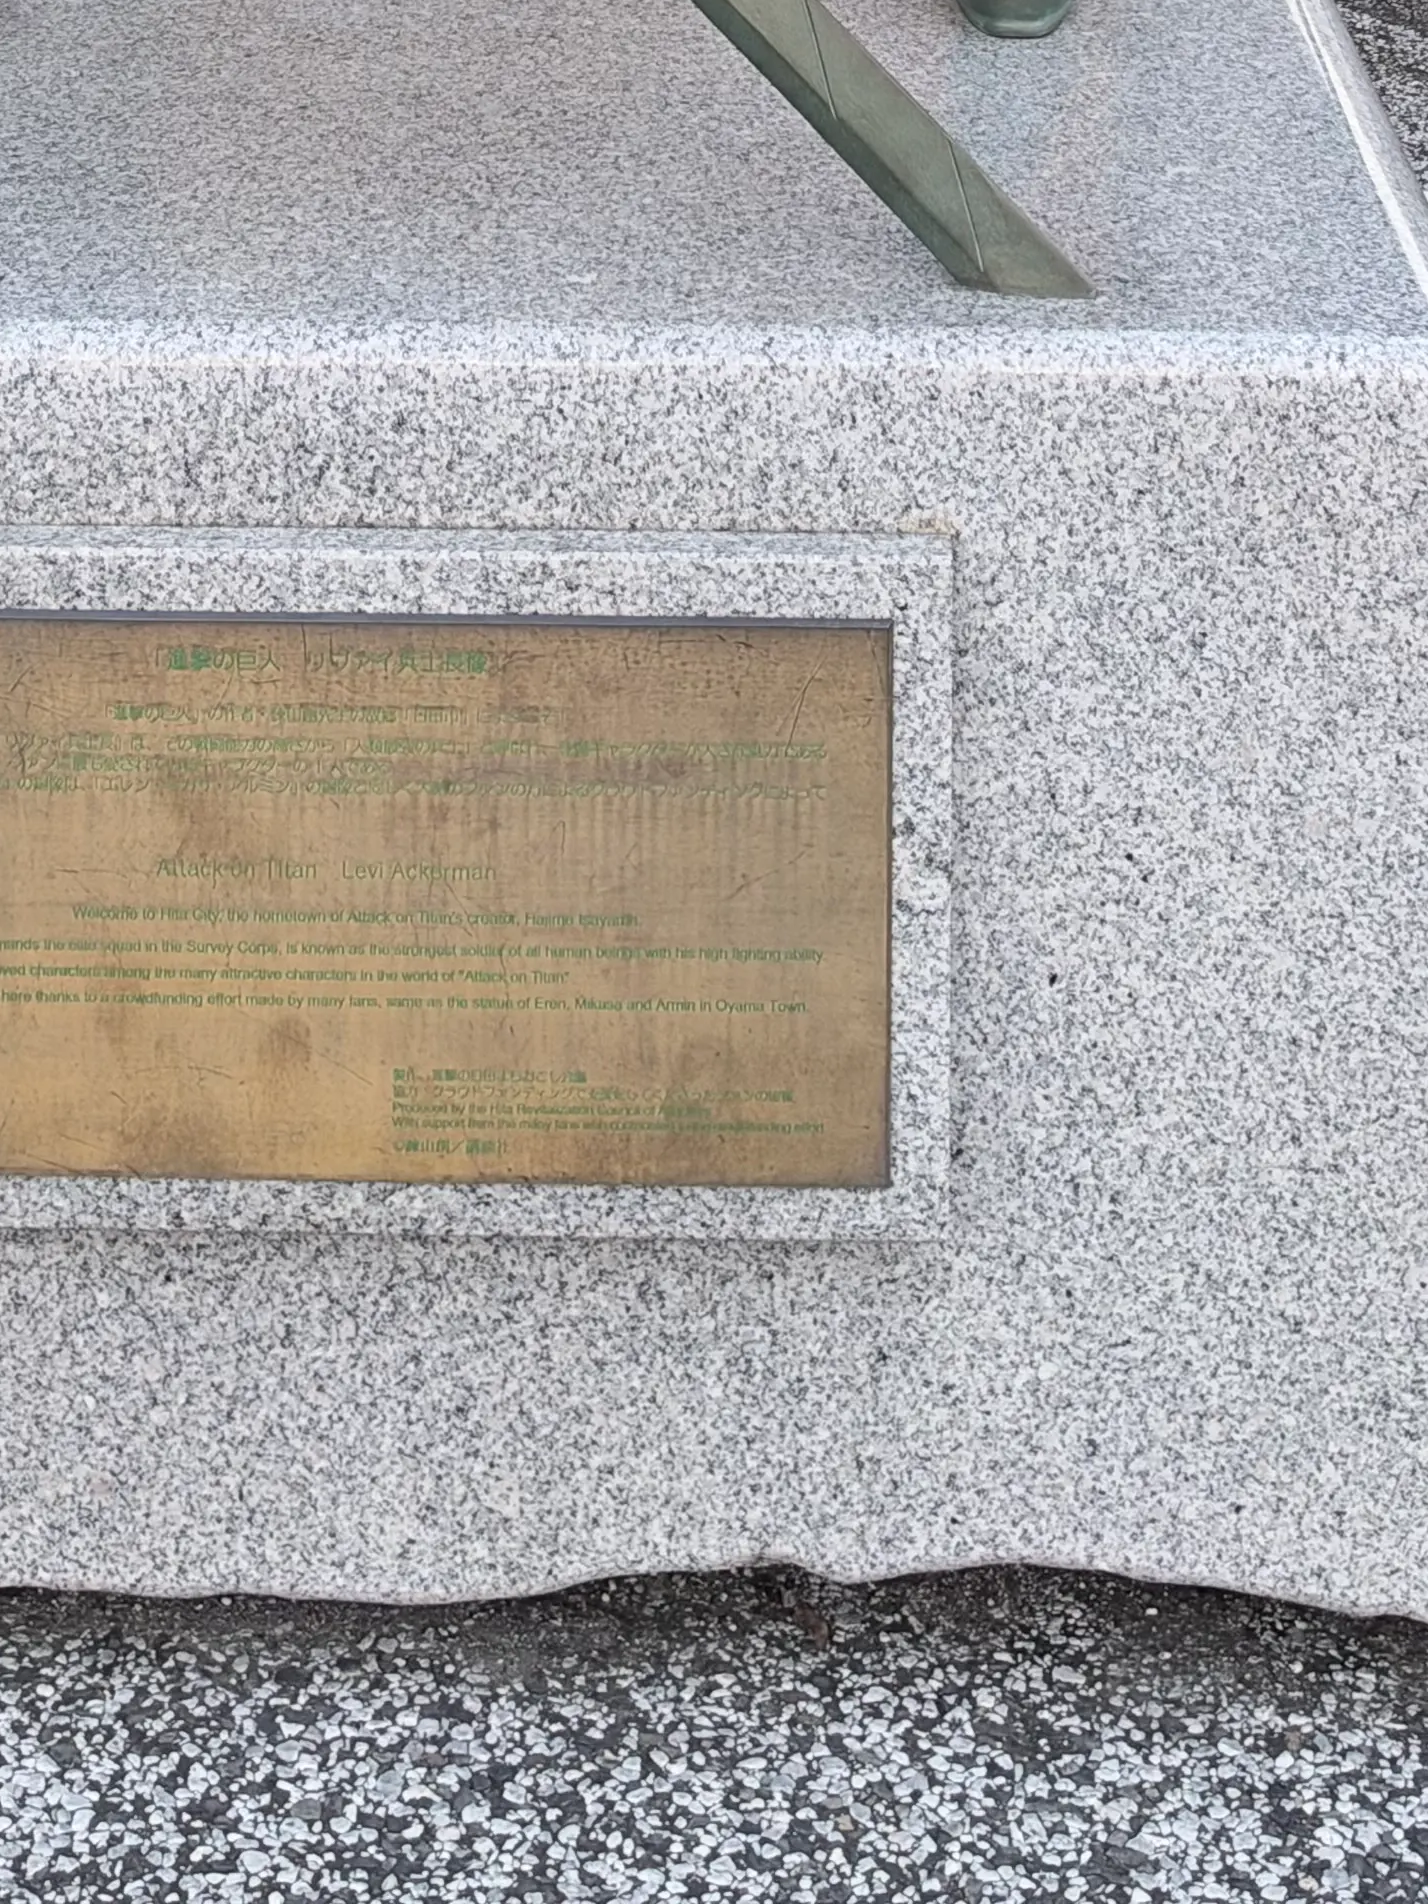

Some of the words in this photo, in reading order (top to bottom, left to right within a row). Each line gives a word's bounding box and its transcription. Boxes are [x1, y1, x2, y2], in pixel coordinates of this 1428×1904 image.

[156, 858, 223, 879] Attack
[230, 863, 255, 879] on
[267, 859, 317, 880] Titan
[342, 859, 383, 880] Levi
[390, 860, 497, 881] Ackerman
[72, 905, 138, 921] Welcome
[227, 907, 250, 923] the
[253, 908, 326, 923] hometown
[346, 909, 390, 924] Attack
[396, 913, 414, 925] on
[418, 910, 463, 925] Titan's
[525, 912, 574, 931] Hajime
